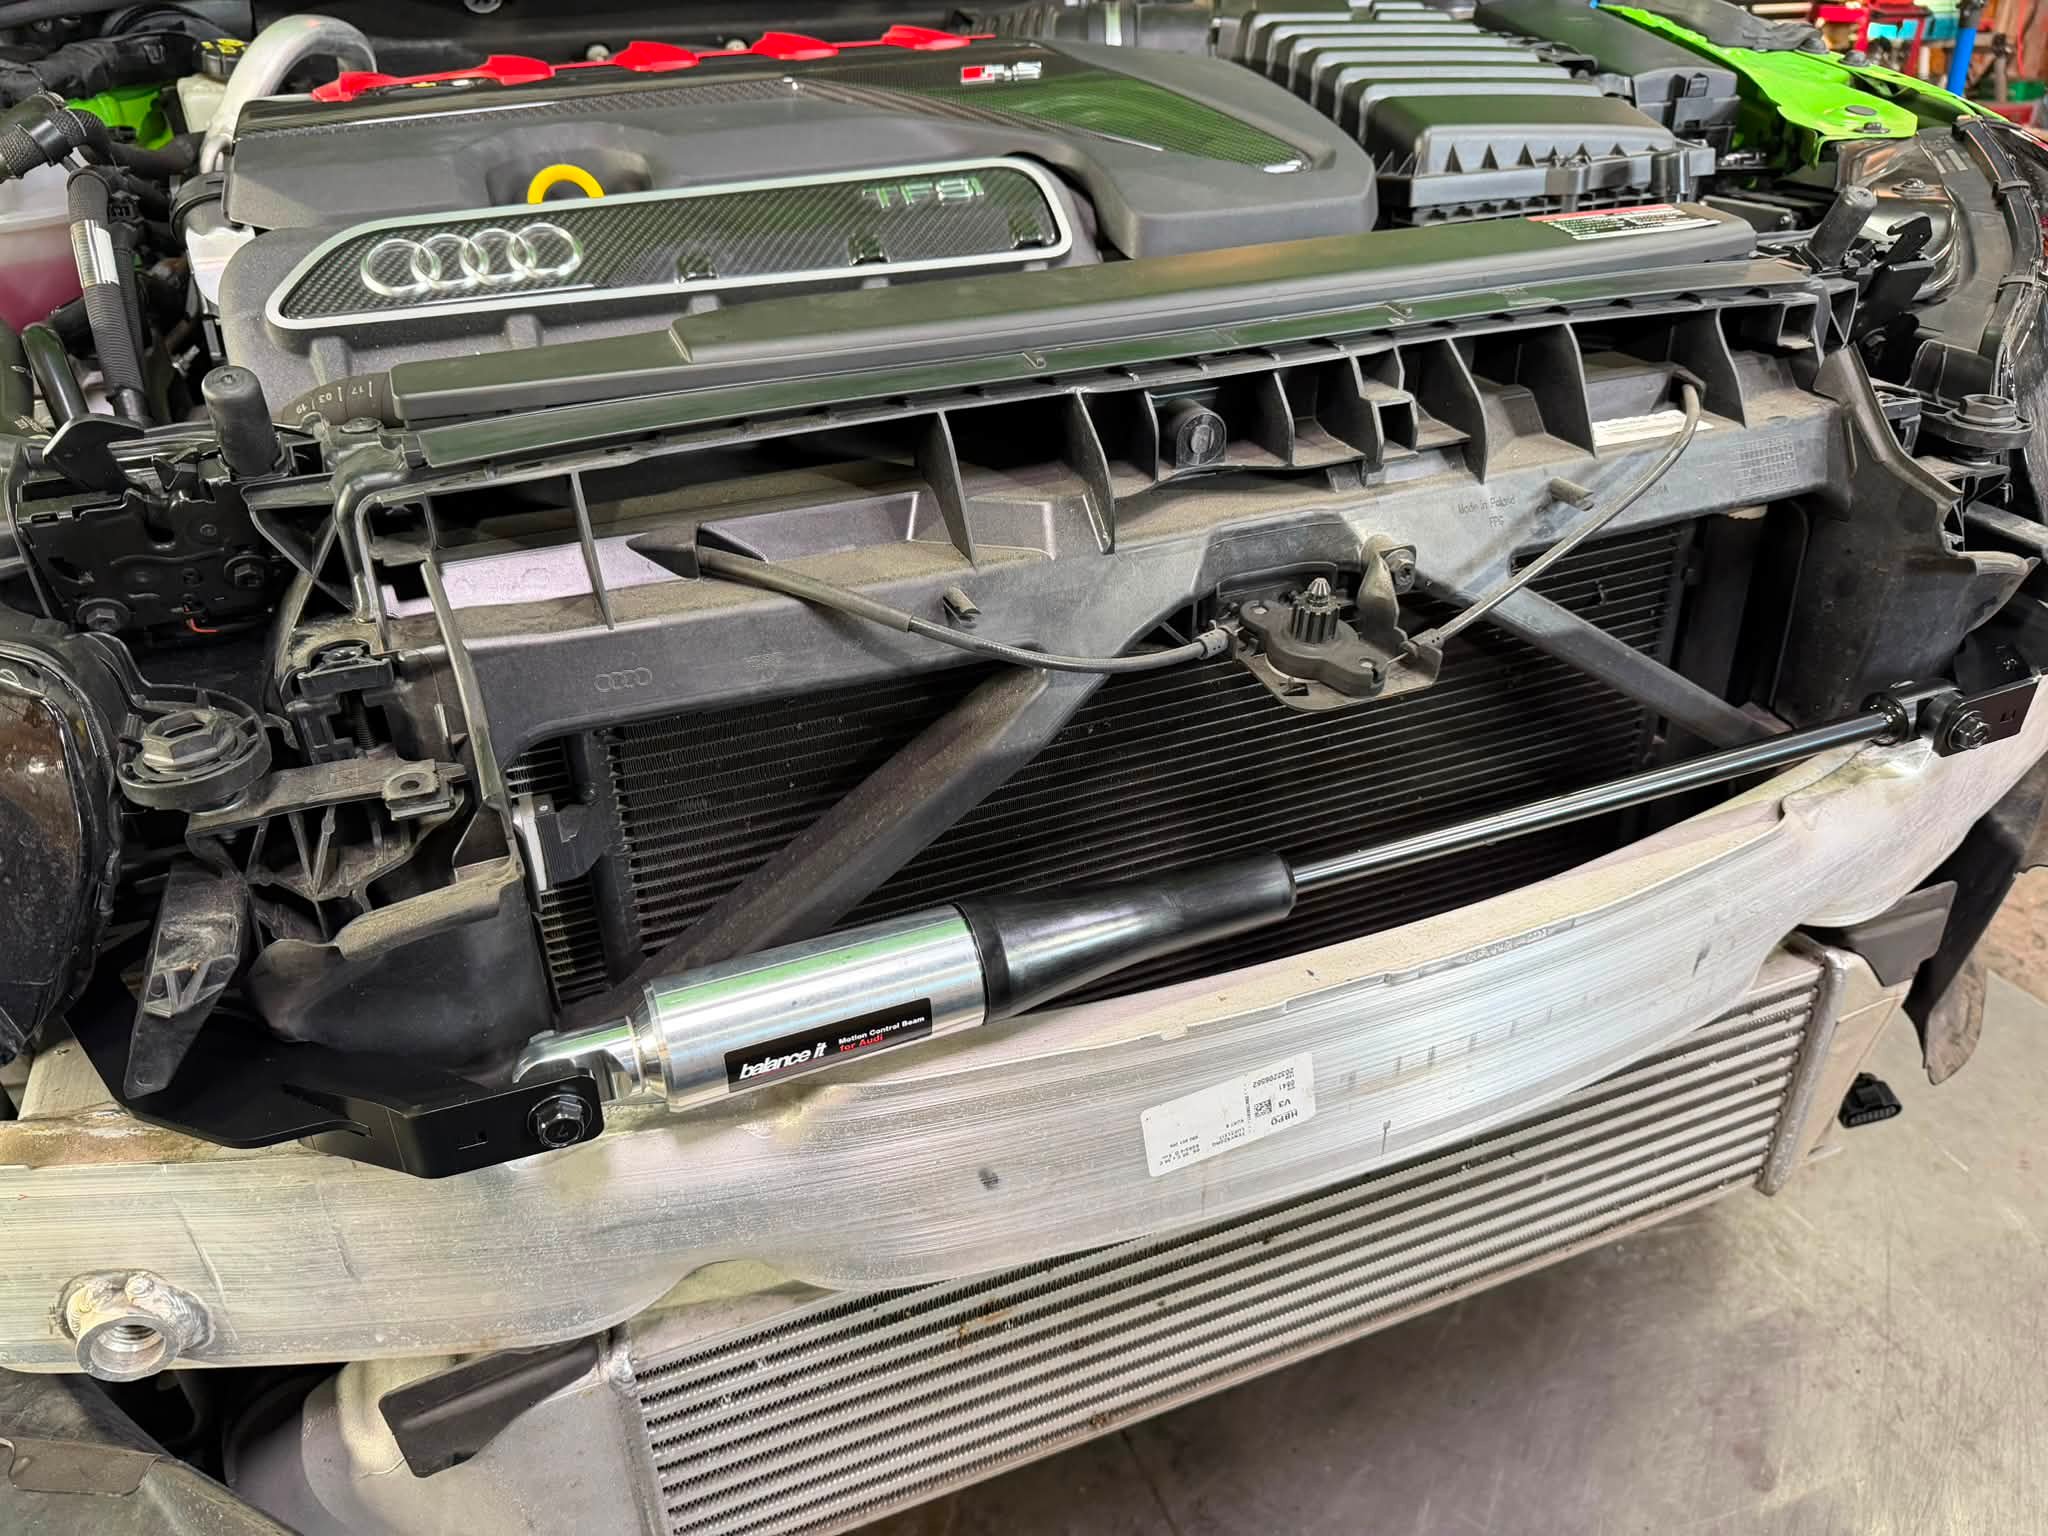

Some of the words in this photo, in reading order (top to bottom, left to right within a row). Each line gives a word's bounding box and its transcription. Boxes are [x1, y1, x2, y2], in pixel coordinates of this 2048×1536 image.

[838, 1031, 868, 1045] Motion
[869, 1022, 900, 1037] Control
[901, 1015, 926, 1028] Beam
[839, 1043, 856, 1053] for
[859, 1034, 884, 1048] Audi
[739, 1049, 811, 1080] balance
[812, 1041, 828, 1060] it
[1278, 1098, 1291, 1108] V3
